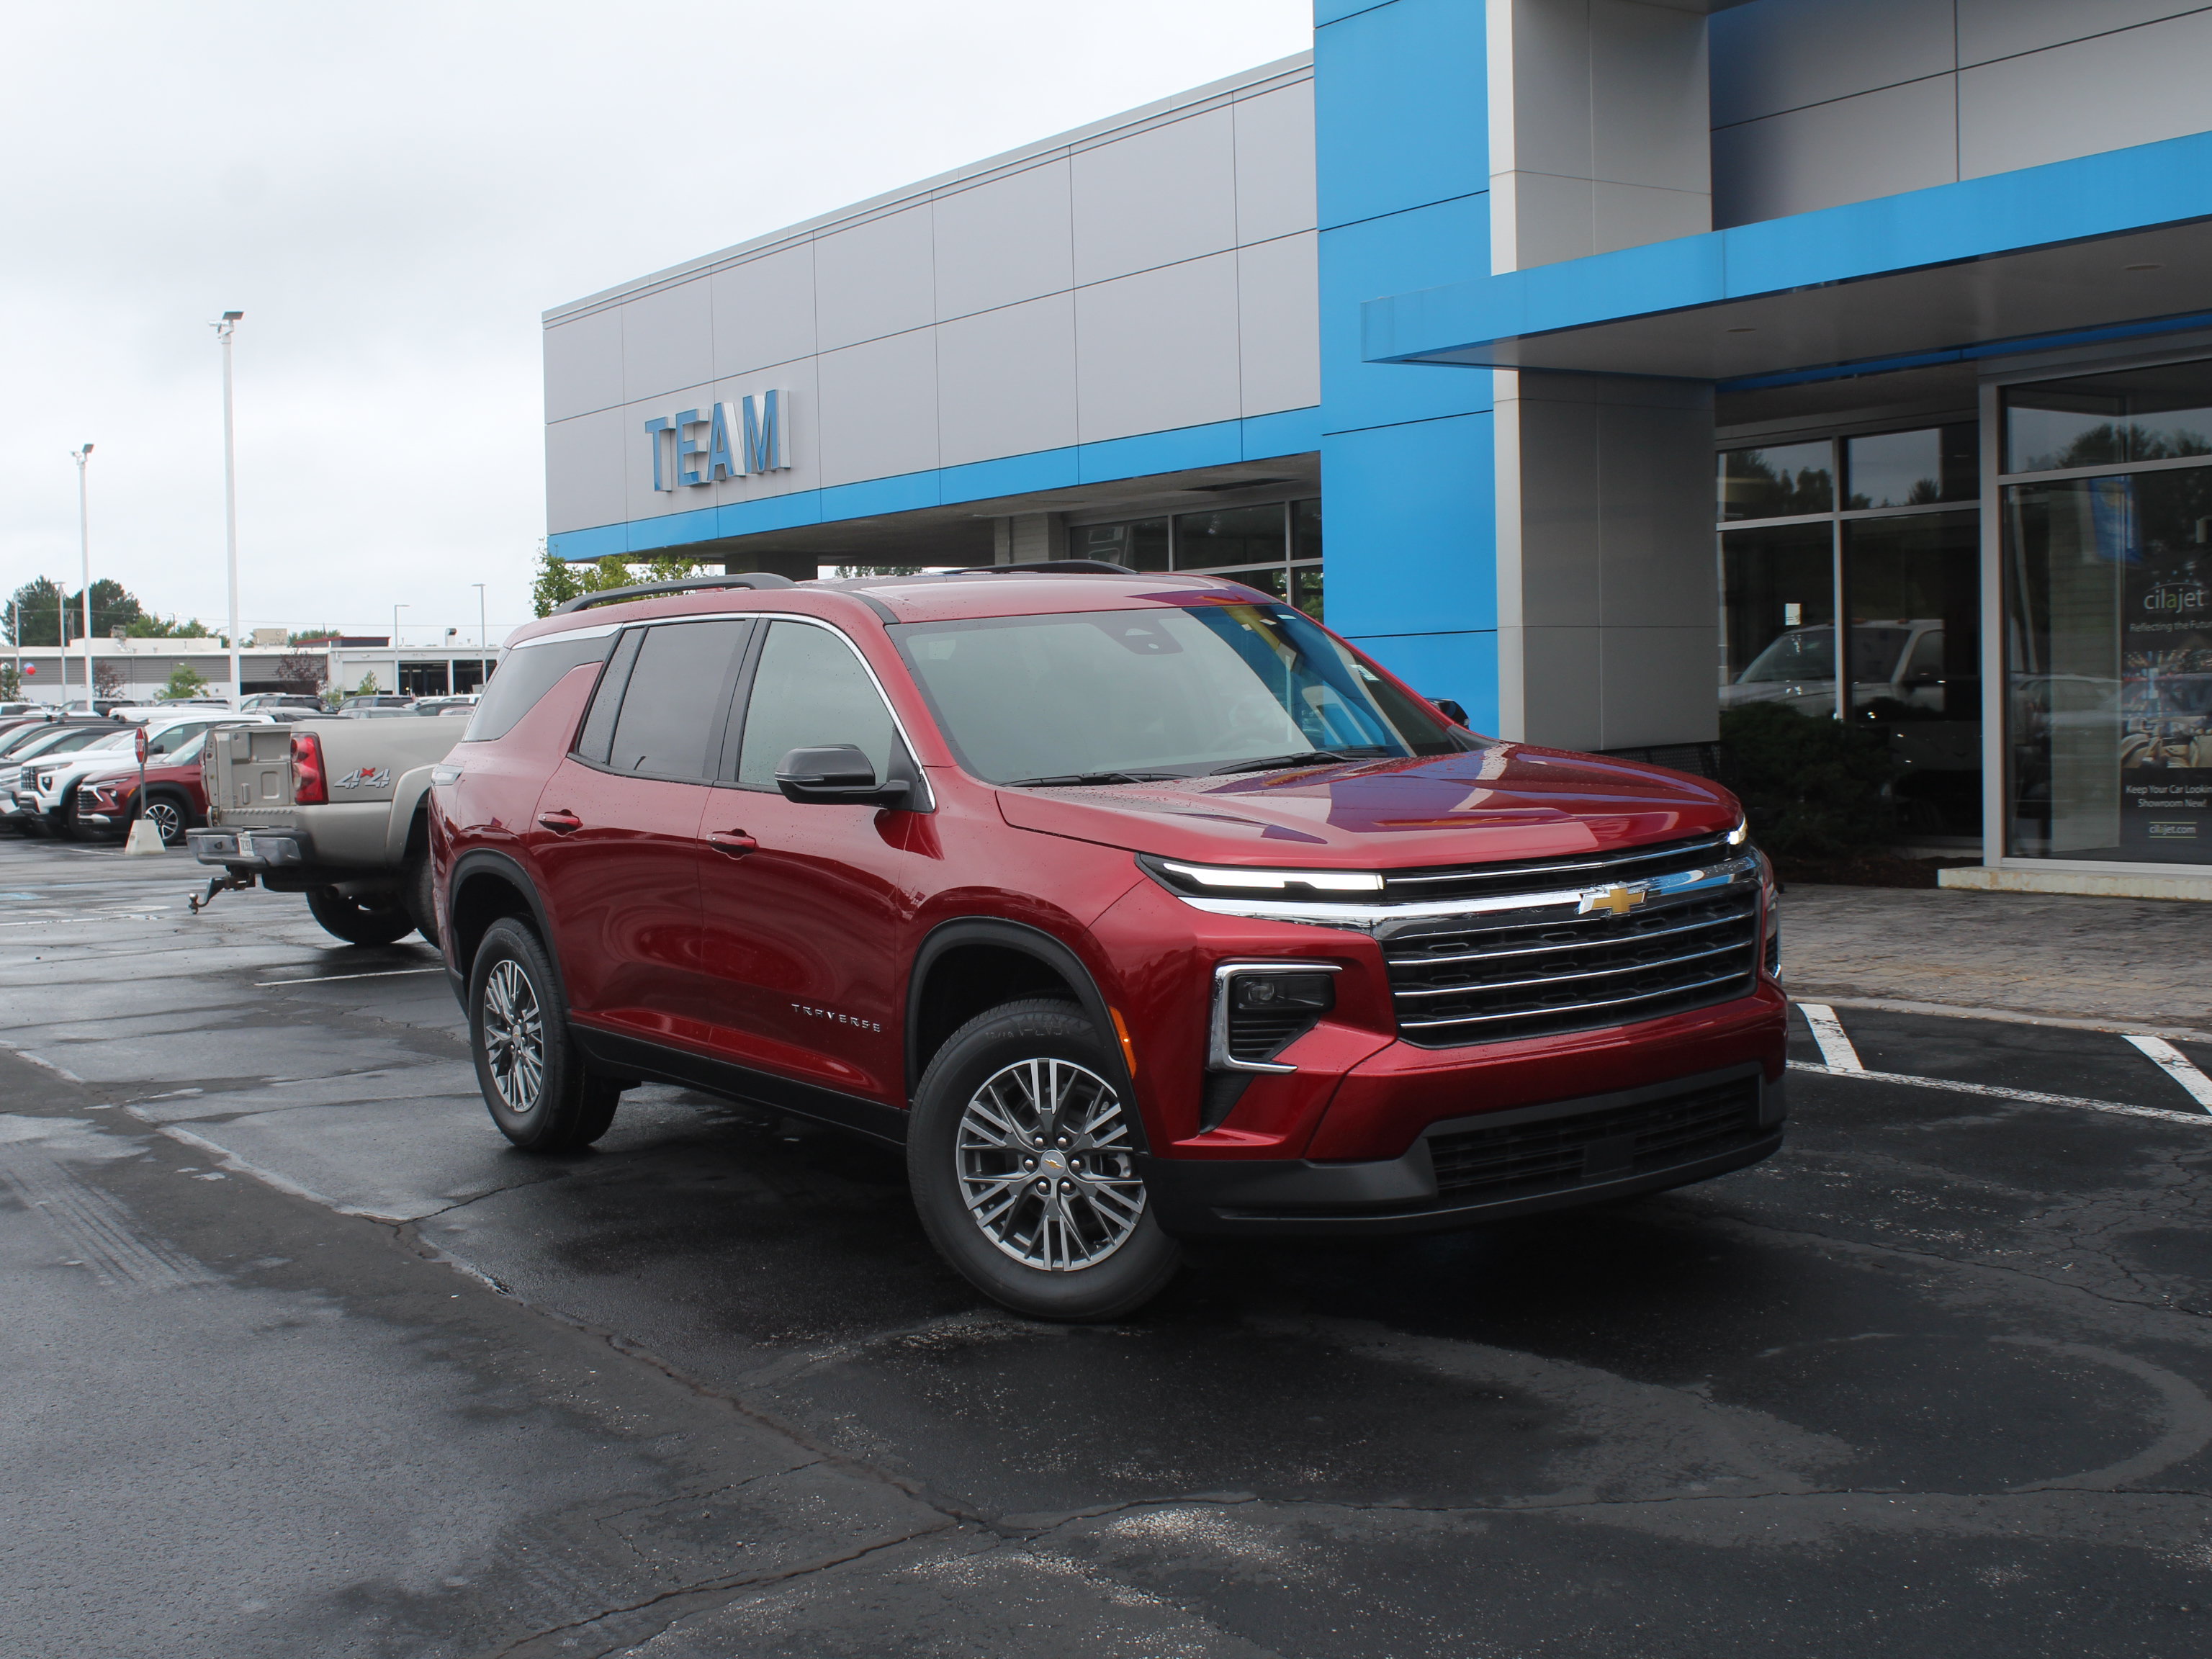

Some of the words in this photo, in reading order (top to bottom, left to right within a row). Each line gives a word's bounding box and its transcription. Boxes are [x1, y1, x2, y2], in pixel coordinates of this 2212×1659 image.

[644, 389, 791, 493] TEAM
[2144, 588, 2205, 613] cilajet
[2174, 621, 2190, 630] the
[135, 738, 144, 752] STOP
[2125, 784, 2149, 796] Keep
[2148, 784, 2169, 794] Your
[2169, 784, 2185, 794] Car
[2185, 783, 2212, 794] Lookin
[2137, 799, 2184, 808] Showroom
[2149, 824, 2196, 835] cilajet.com
[791, 1004, 881, 1033] TRAVERSE
